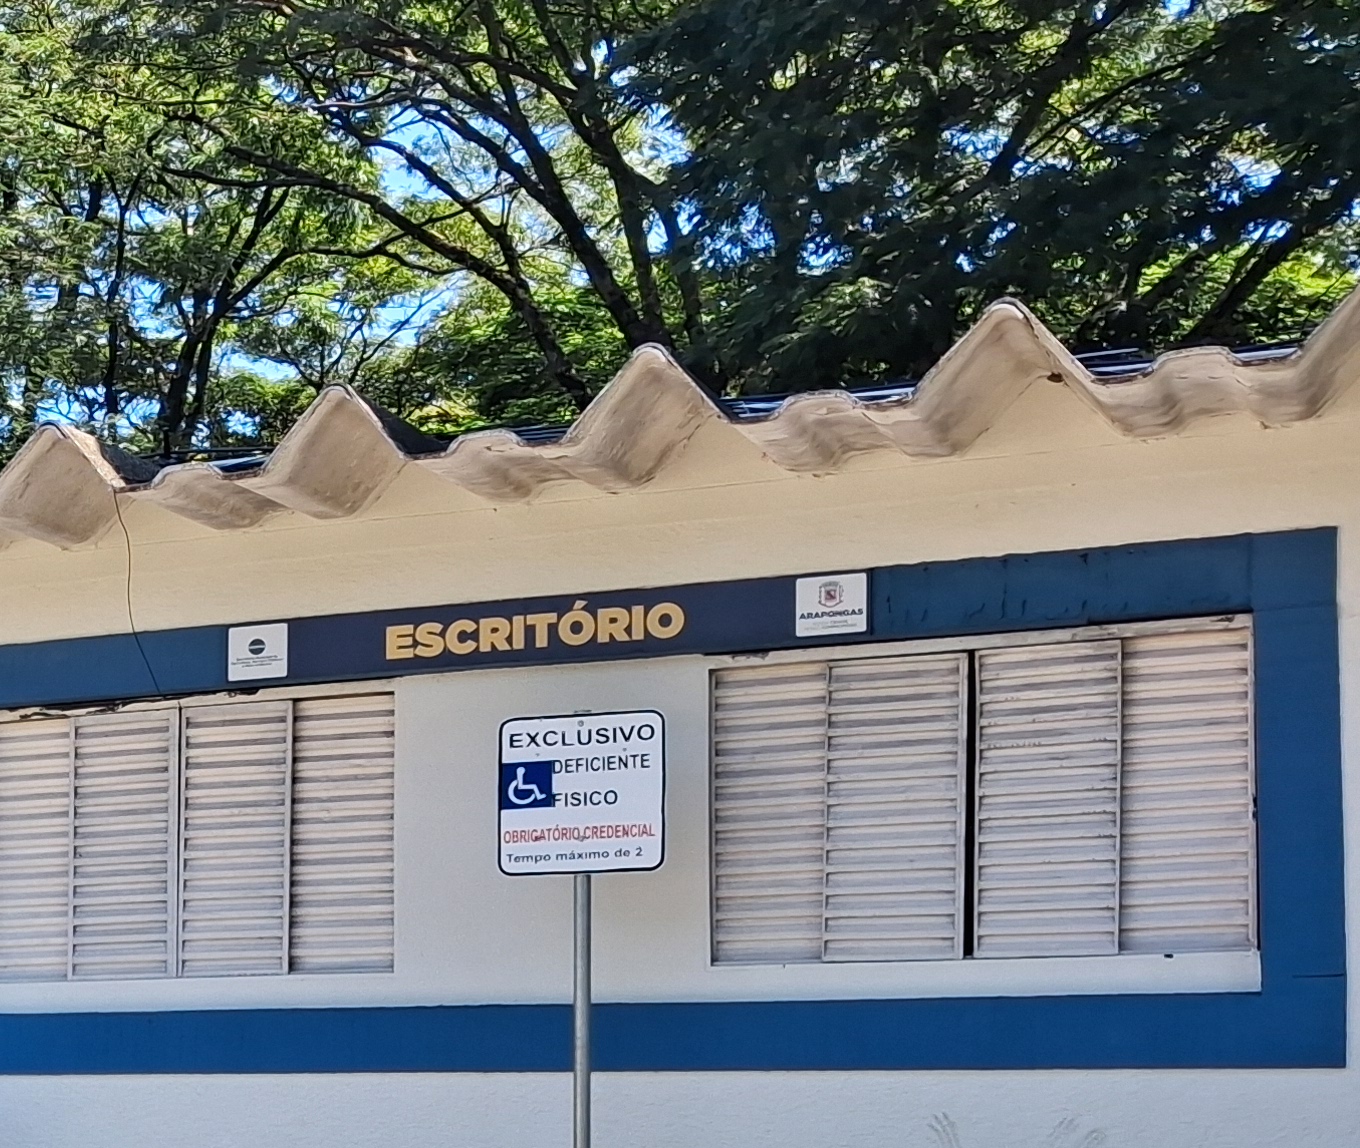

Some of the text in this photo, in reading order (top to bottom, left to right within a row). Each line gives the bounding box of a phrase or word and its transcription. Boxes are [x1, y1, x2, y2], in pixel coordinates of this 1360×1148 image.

[799, 608, 864, 620] ARAPONGAS
[385, 600, 686, 661] ESCRITÓRIO
[509, 723, 655, 749] EXCLUSIVO
[552, 753, 651, 775] DEFICIENTE
[552, 789, 618, 808] FISICO
[506, 845, 643, 865] Tempo máximo de 2
